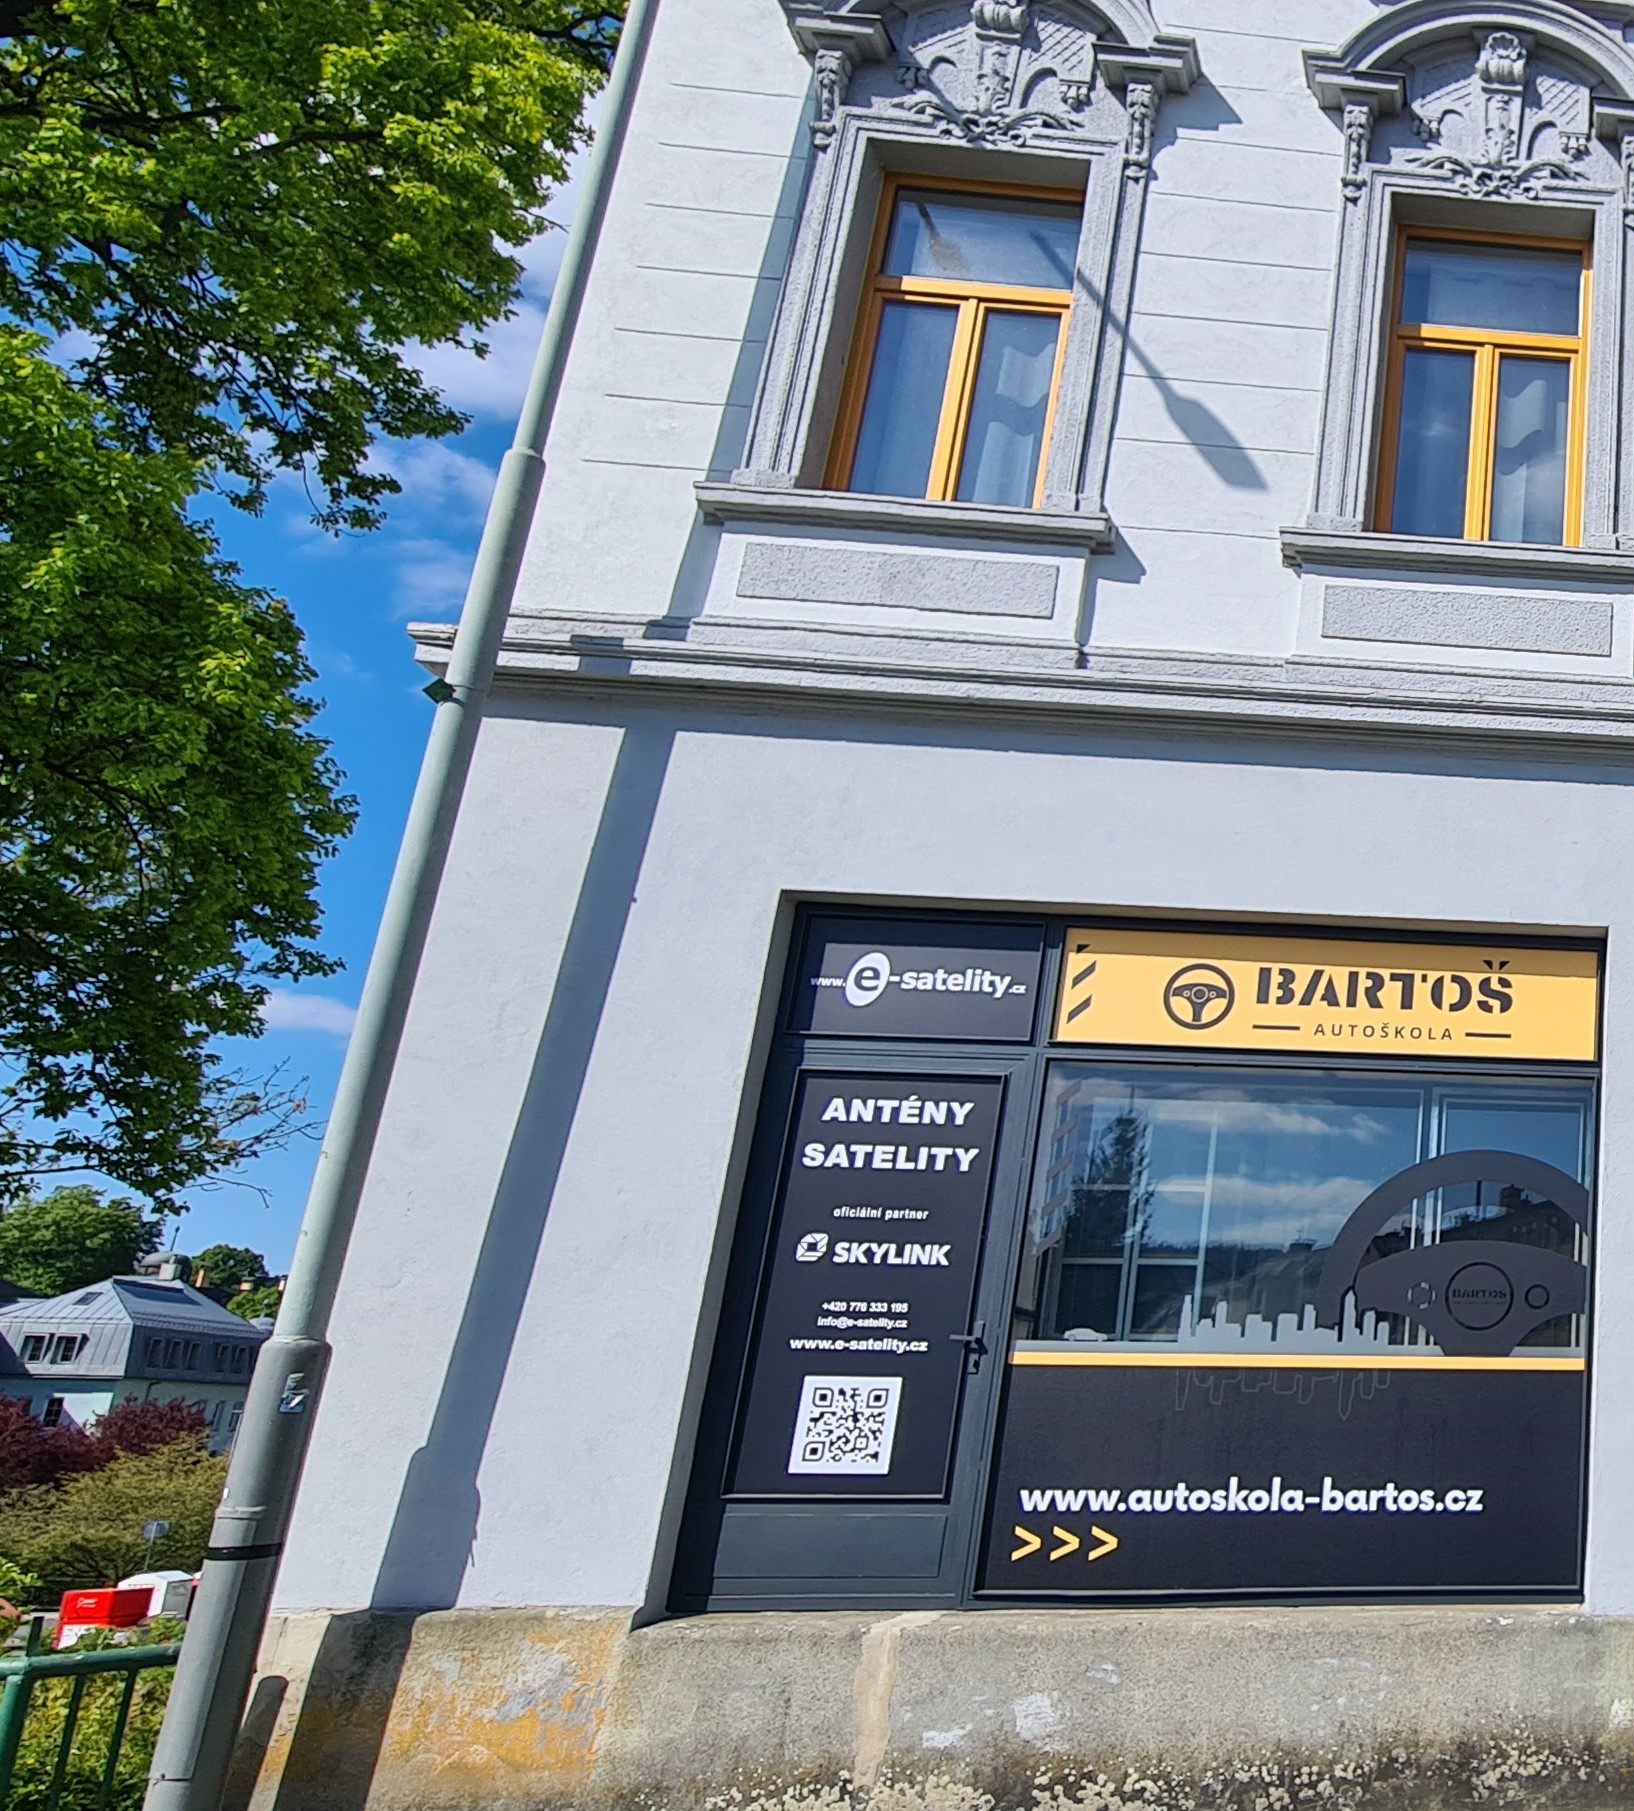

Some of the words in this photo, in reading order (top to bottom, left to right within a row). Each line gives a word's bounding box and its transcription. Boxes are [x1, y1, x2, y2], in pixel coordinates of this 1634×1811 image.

[1255, 960, 1514, 1015] BARTOŠ
[1313, 1021, 1454, 1042] AUTOŠKOLA
[821, 1095, 975, 1126] ANTÉNY
[802, 1143, 980, 1173] SATELITY
[833, 1206, 883, 1219] oficiální
[884, 1208, 929, 1221] partner
[832, 1241, 951, 1266] SKYLINK
[822, 1301, 847, 1312] +420
[869, 1301, 888, 1313] 333
[890, 1302, 909, 1313] 195
[817, 1316, 908, 1330] info@e-satelity.cz
[789, 1337, 929, 1354] www.e-satelity.cz
[1019, 1476, 1484, 1513] www.autoskola-bartos.cz
